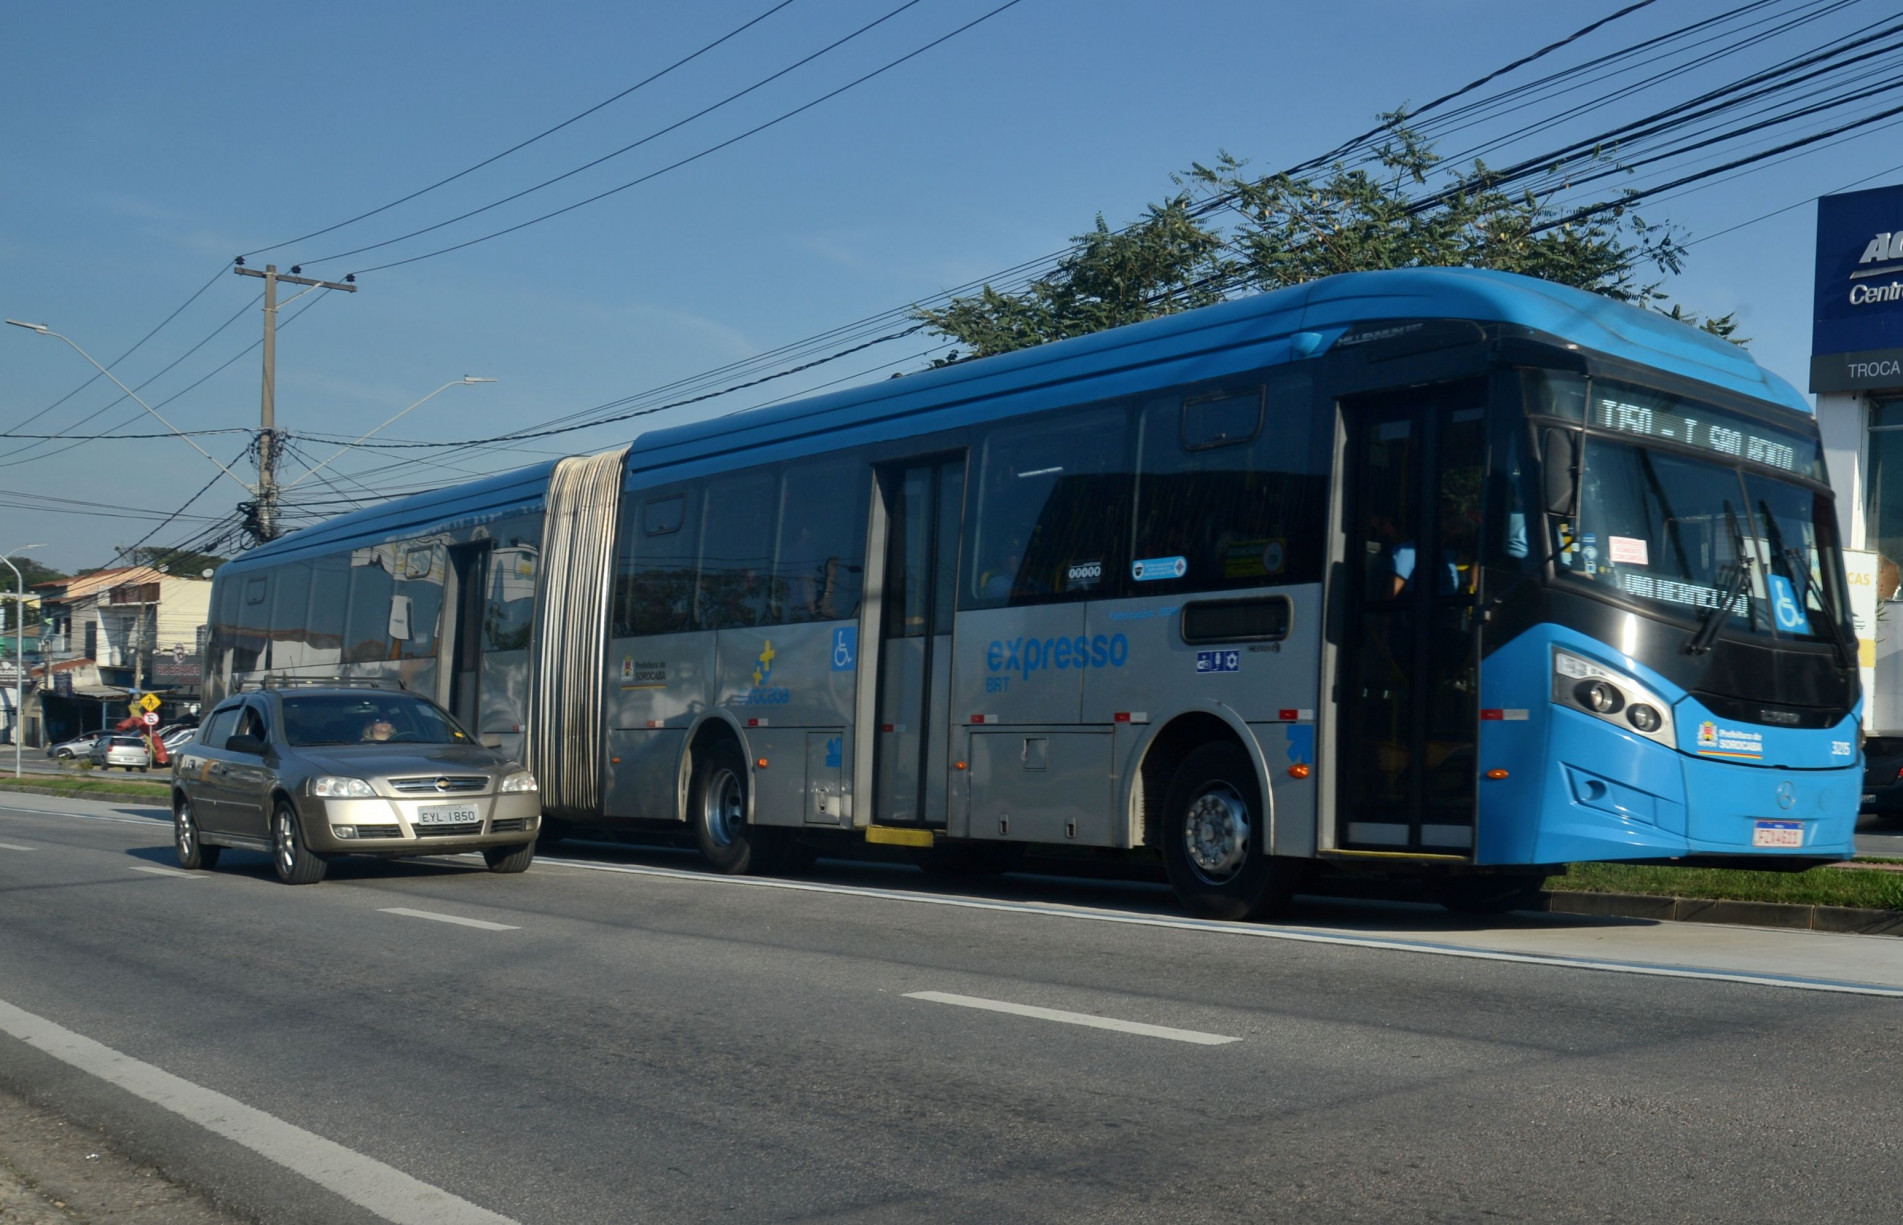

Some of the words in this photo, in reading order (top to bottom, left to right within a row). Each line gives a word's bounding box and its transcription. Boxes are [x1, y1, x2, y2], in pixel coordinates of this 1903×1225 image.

[1848, 360, 1901, 378] TROCA
[1068, 565, 1101, 579] 00000
[987, 633, 1128, 681] expresso
[986, 676, 1010, 693] BRT
